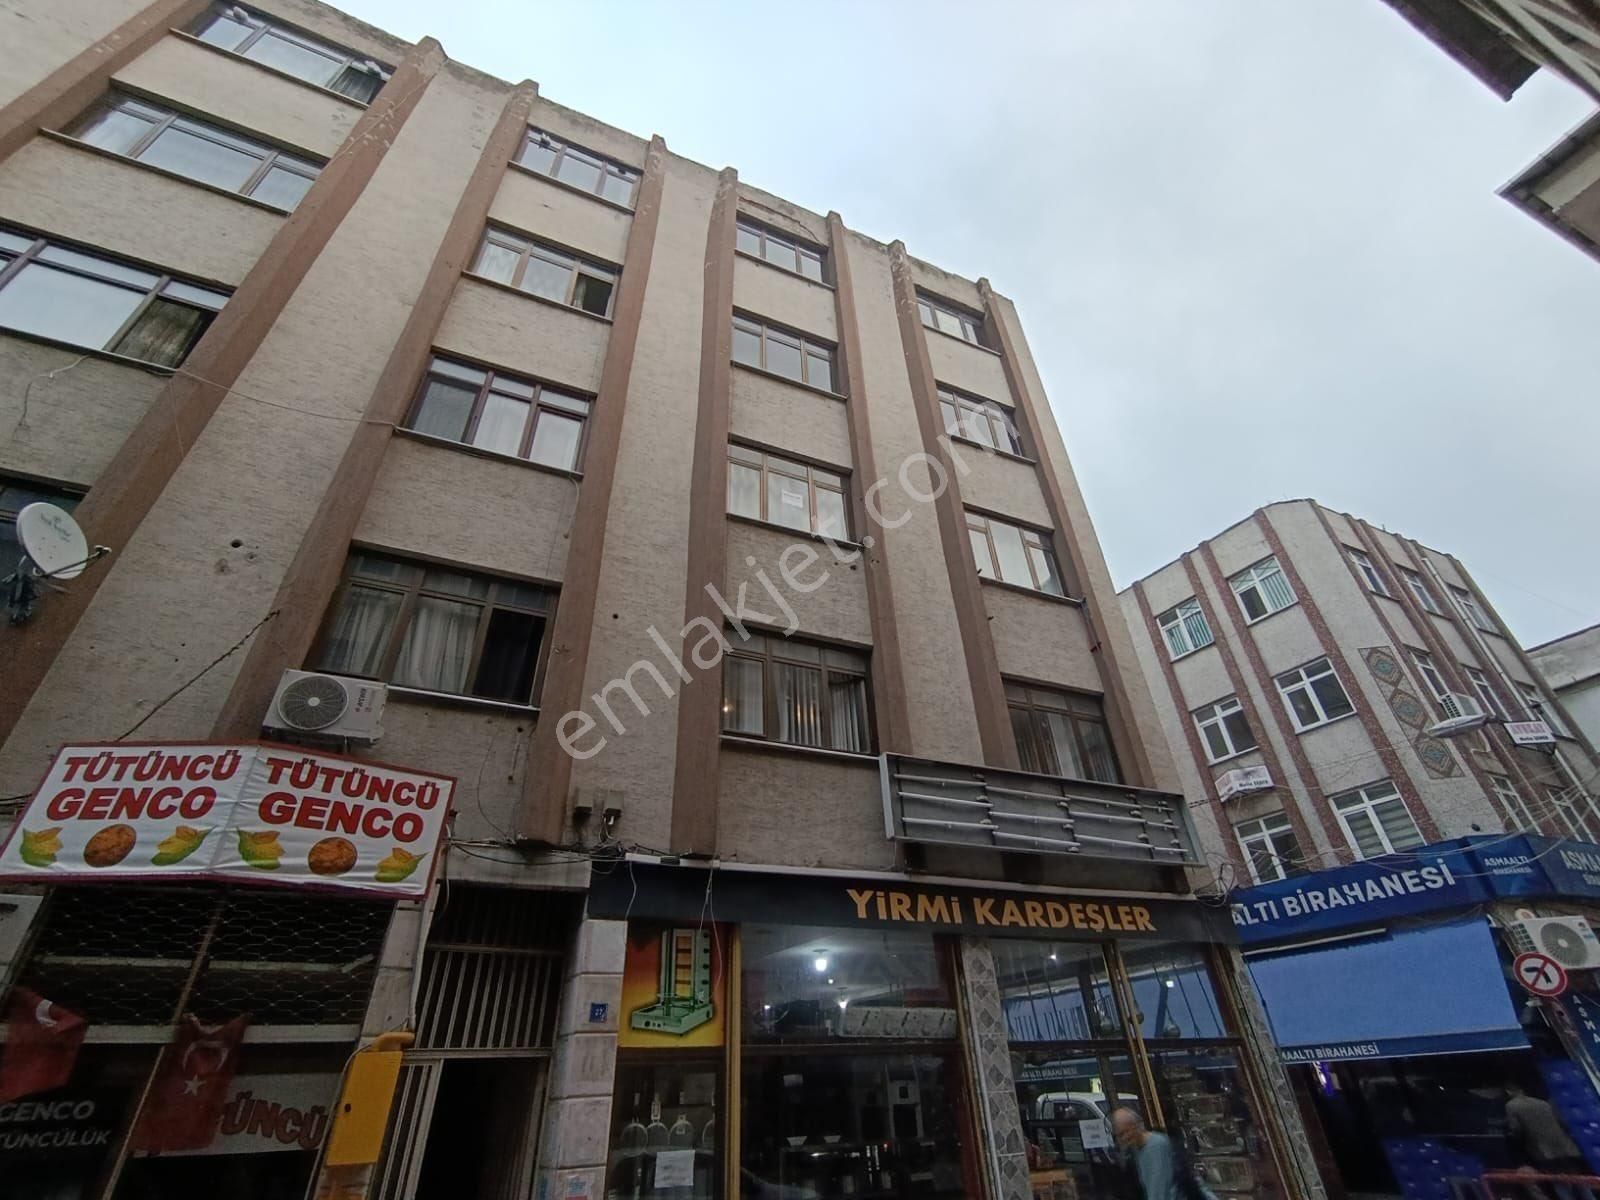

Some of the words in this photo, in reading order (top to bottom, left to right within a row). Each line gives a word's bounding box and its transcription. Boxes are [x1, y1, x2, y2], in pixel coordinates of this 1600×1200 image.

[62, 750, 241, 784] TÜTÜNCÜ
[265, 757, 440, 810] TÜTÜNCÜ
[46, 786, 217, 822] GENCO
[257, 791, 424, 844] GENCO
[1281, 857, 1456, 917] BİRAHANESİ
[973, 897, 1157, 932] KARDEŞLER
[1315, 1041, 1380, 1059] BİRAHANESİ
[0, 1100, 96, 1121] GENCO
